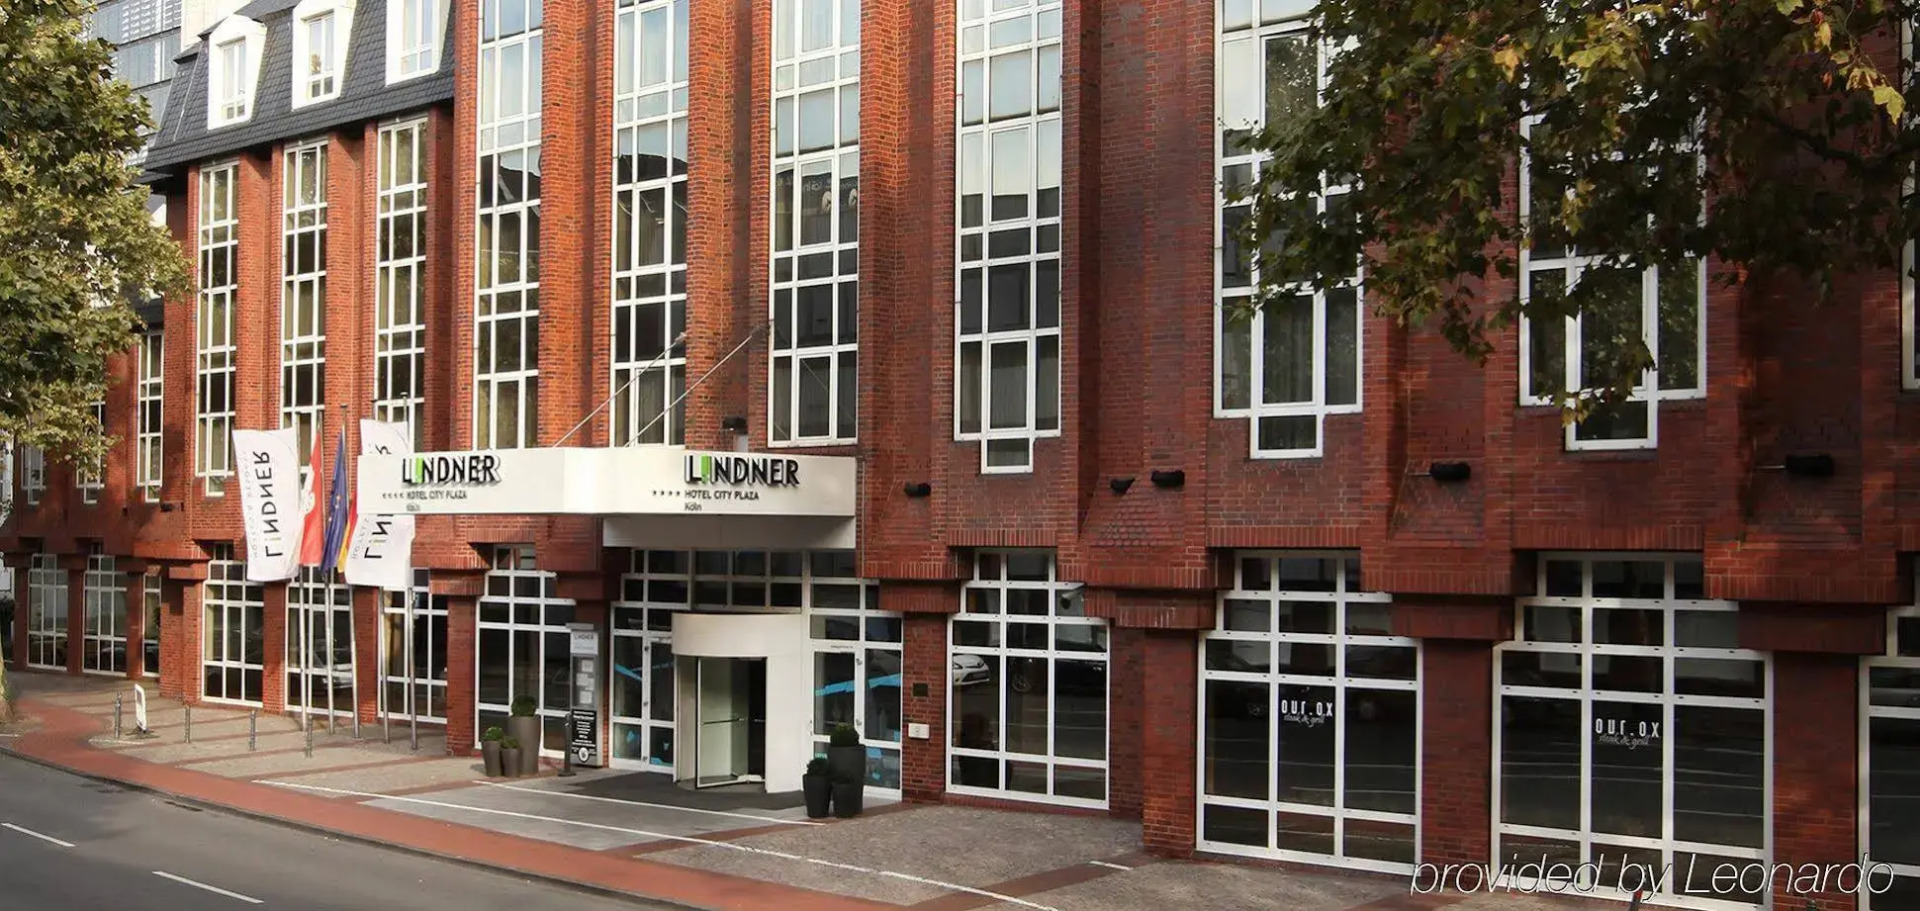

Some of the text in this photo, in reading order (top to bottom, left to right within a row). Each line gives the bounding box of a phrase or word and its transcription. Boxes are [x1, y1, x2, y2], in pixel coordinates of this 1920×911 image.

[429, 490, 443, 499] CITY
[446, 490, 467, 499] PLAZA
[685, 490, 759, 501] HOTEL CITY PLAZA
[685, 502, 702, 511] Köln
[1620, 735, 1630, 745] &
[1629, 734, 1650, 750] grill
